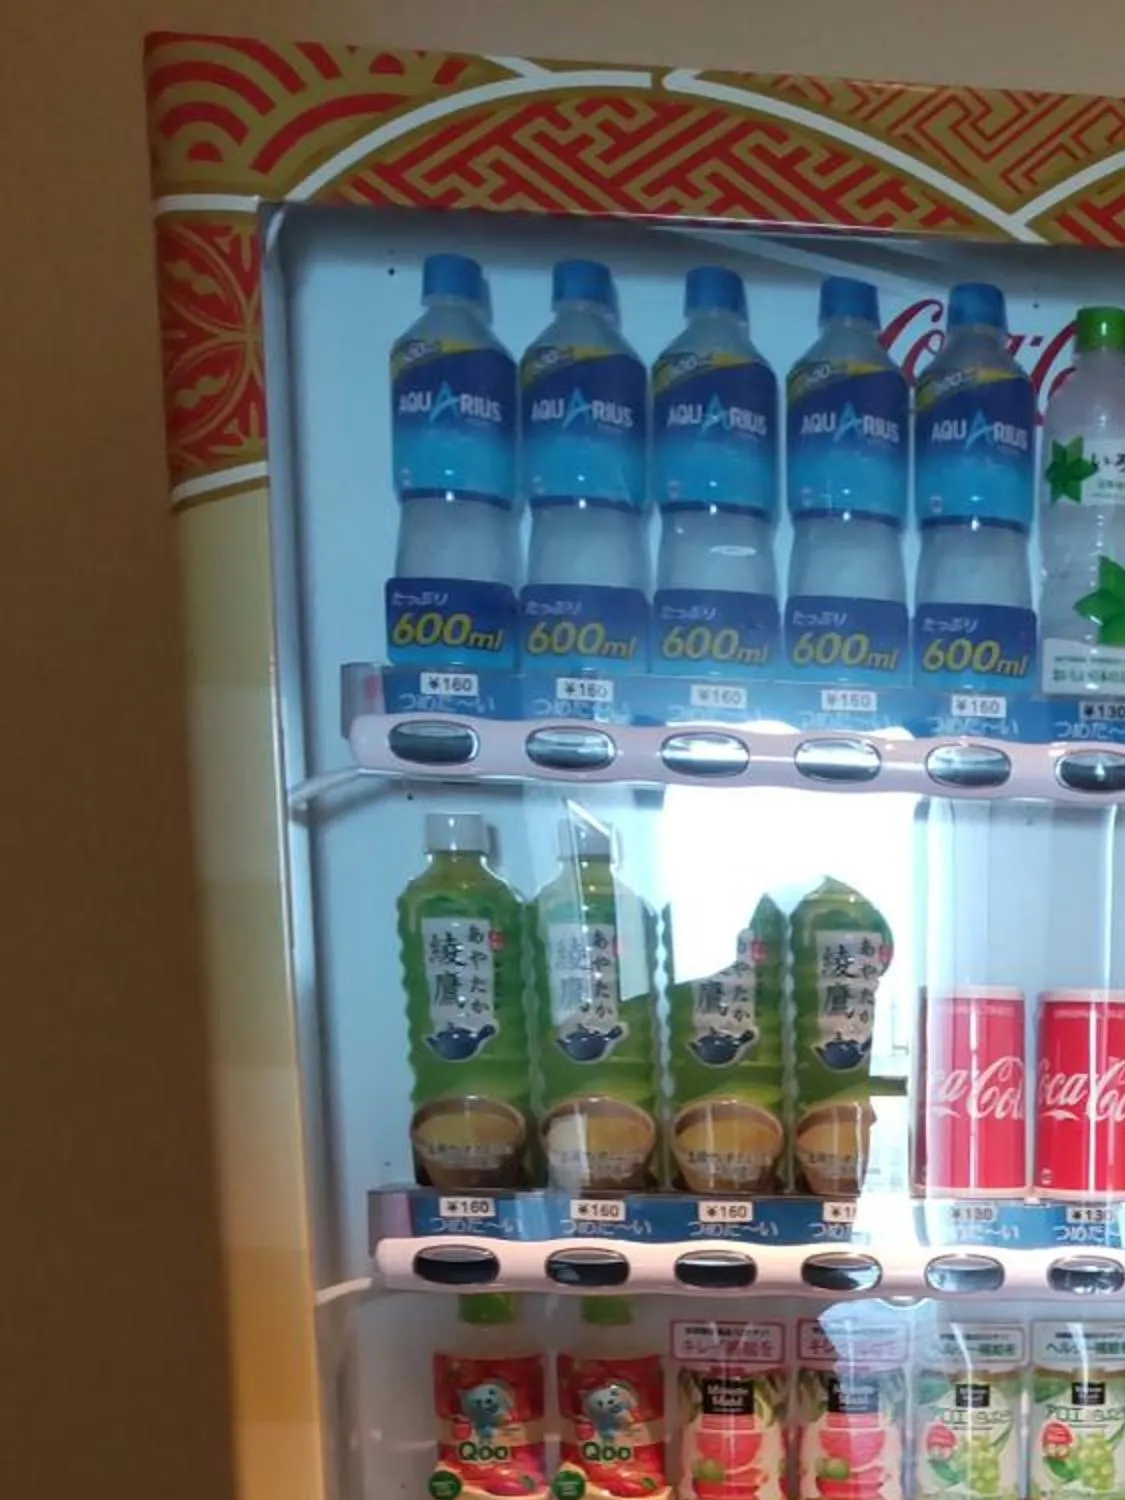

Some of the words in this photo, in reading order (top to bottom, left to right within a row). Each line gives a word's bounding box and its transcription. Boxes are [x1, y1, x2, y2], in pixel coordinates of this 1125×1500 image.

[399, 381, 502, 422] AQUARIUS
[531, 387, 633, 428] AQUARIUS
[667, 393, 767, 435] AQUARIUS
[801, 403, 899, 443] AQUARIUS
[931, 410, 1029, 450] AQUARIUS
[392, 612, 503, 650] 600ml
[527, 621, 637, 659] 600ml
[662, 626, 769, 664] 600ml
[791, 631, 900, 670] 600ml
[922, 638, 1030, 678] 600ml
[447, 1201, 489, 1213] ¥160
[578, 1204, 620, 1217] ¥160
[707, 1206, 747, 1218] ¥160
[831, 1206, 857, 1218] ¥1
[458, 1440, 510, 1462] Qoo
[582, 1440, 631, 1462] Qoo
